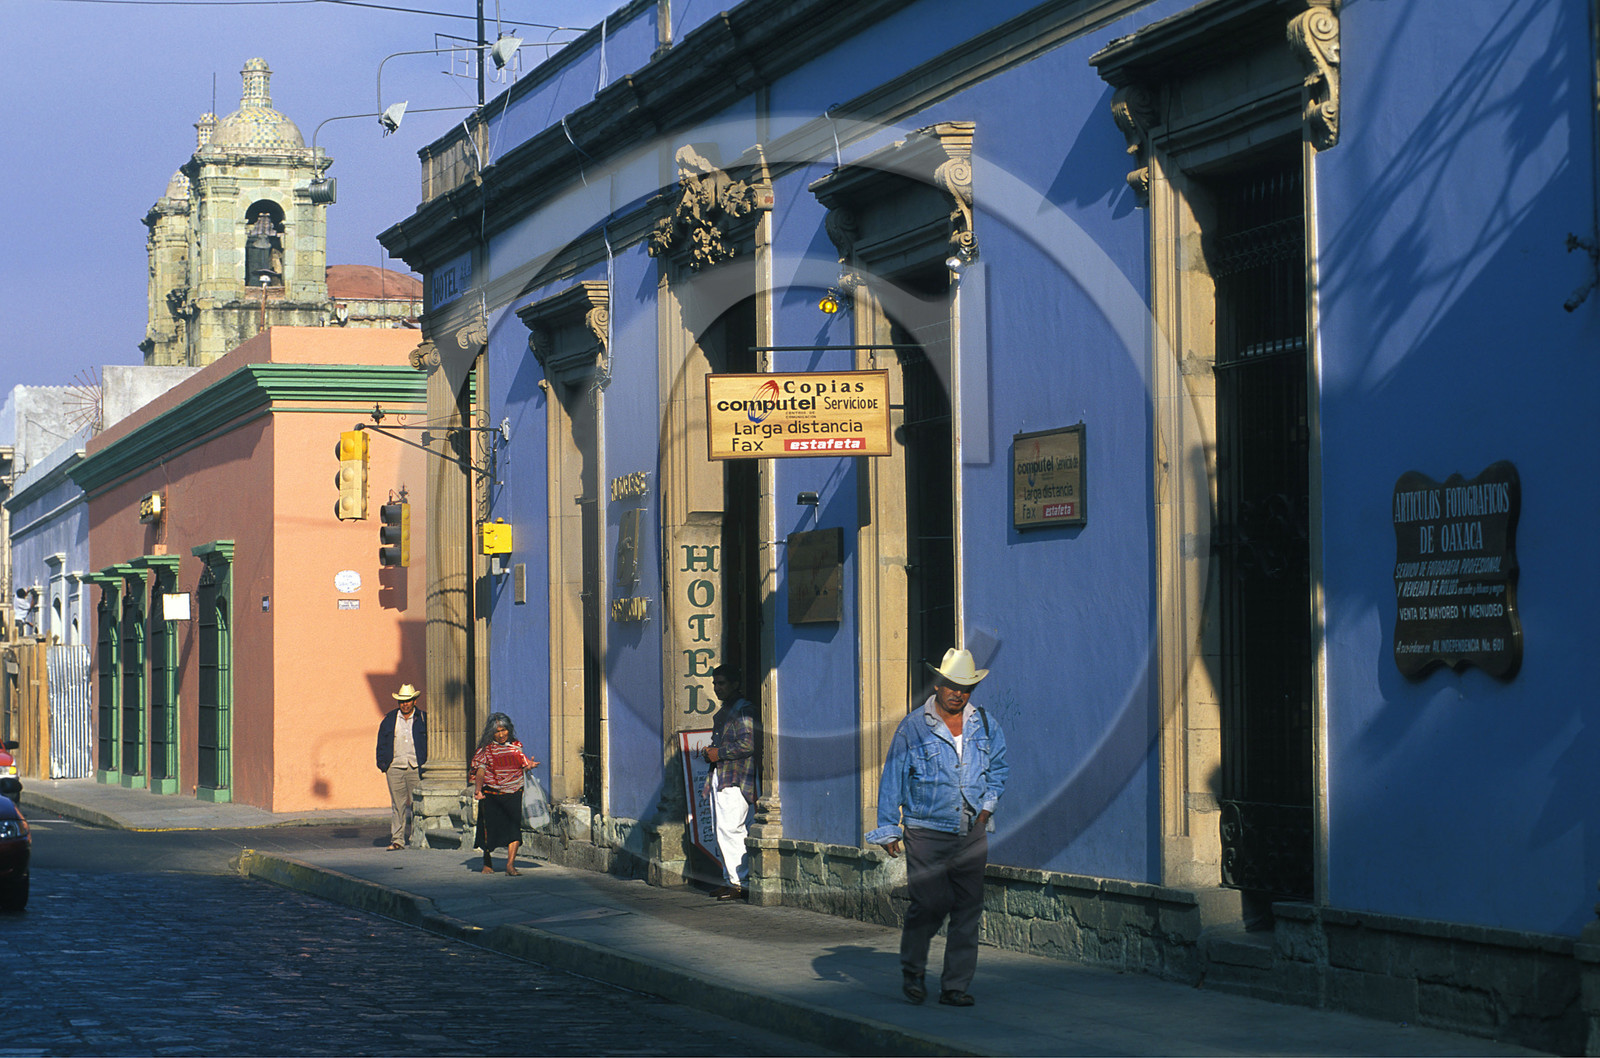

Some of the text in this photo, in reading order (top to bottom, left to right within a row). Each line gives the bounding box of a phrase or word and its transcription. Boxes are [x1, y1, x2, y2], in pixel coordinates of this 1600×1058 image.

[434, 267, 458, 305] HOTEL
[784, 380, 865, 396] Copias
[717, 396, 816, 413] computel
[824, 396, 867, 410] Servicio
[735, 419, 863, 438] Larga distancia
[732, 438, 861, 452] Fax estafeta
[1017, 456, 1054, 475] computel
[1024, 482, 1073, 504] Larga distancia
[1394, 482, 1510, 523] ARTICULOS FOTOGRAFICOS
[1022, 504, 1072, 519] Fax estafeta
[1420, 521, 1483, 554] DE OAXACA
[1402, 580, 1430, 597] REVELADO
[1430, 579, 1440, 596] DE
[1399, 603, 1504, 620] VENTA DE MAYOREO Y MENUDEO
[680, 544, 720, 715] HOTEL
